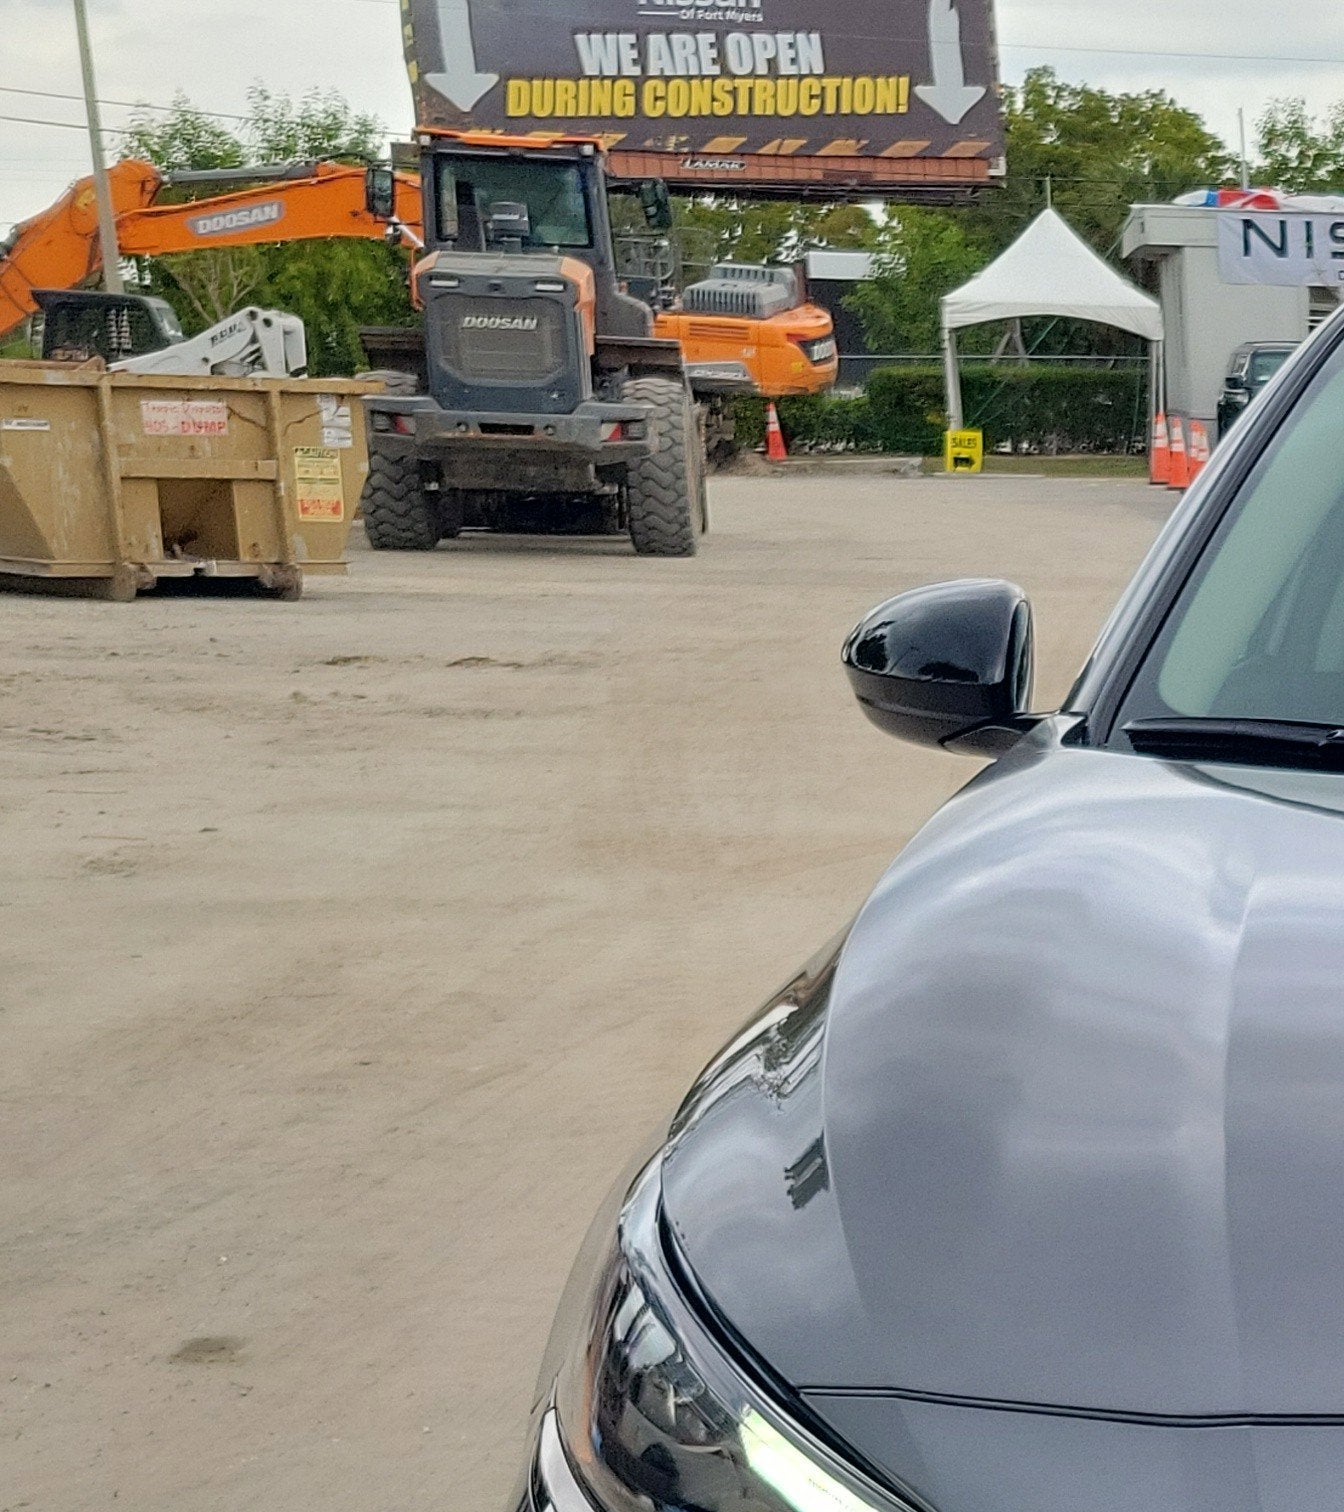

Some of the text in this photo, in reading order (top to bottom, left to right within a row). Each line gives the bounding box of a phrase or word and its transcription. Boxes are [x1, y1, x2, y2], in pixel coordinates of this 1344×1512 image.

[696, 10, 724, 20] Fort
[725, 10, 763, 23] Myers
[574, 32, 825, 76] WE ARE OPEN
[506, 75, 910, 118] DURING CONSTRUCTION!
[197, 203, 280, 235] DOOSAN
[462, 315, 538, 331] DOOSAN
